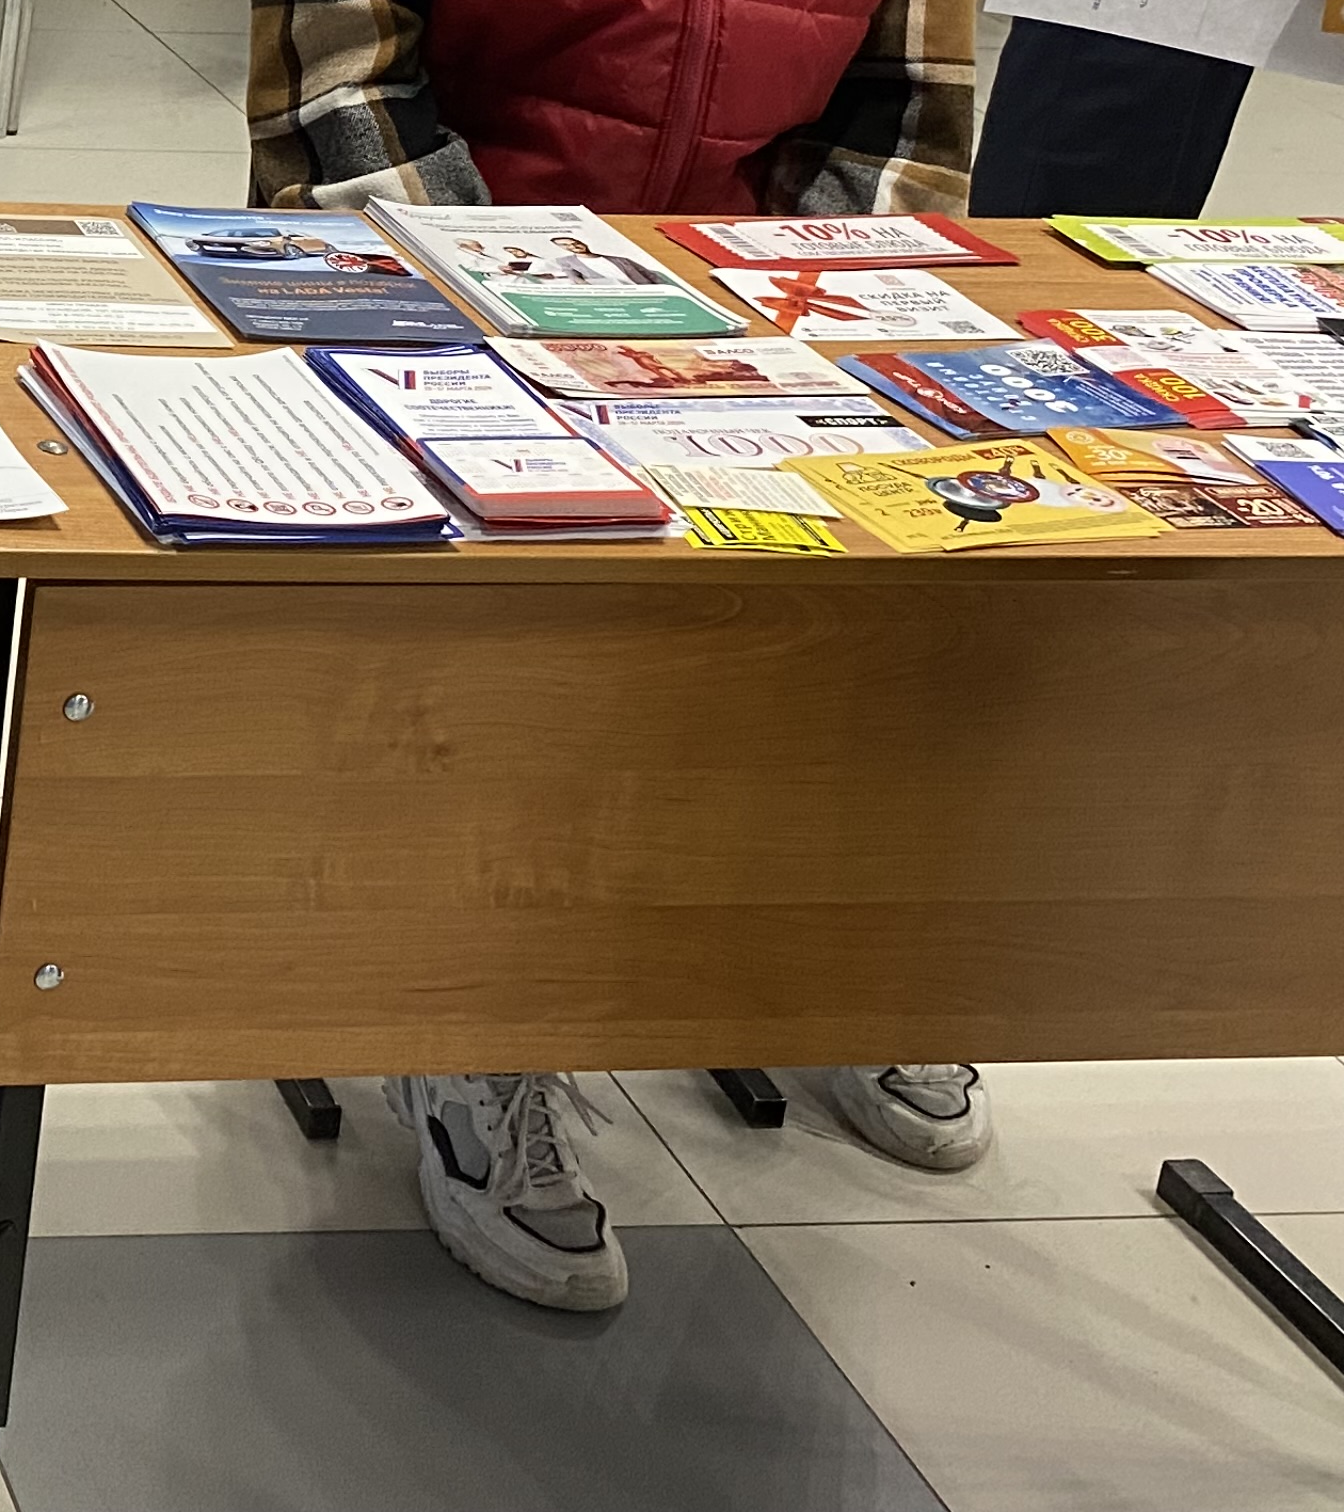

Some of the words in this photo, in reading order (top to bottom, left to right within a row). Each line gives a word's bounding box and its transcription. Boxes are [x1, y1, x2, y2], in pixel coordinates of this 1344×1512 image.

[773, 222, 871, 241] -10%
[872, 227, 910, 239] НА
[1168, 228, 1270, 245] -10%
[1272, 235, 1311, 244] НА
[865, 238, 931, 250] БЛЮДА
[283, 287, 332, 296] LADA
[973, 363, 1085, 413] 3000
[663, 433, 865, 458] 1000
